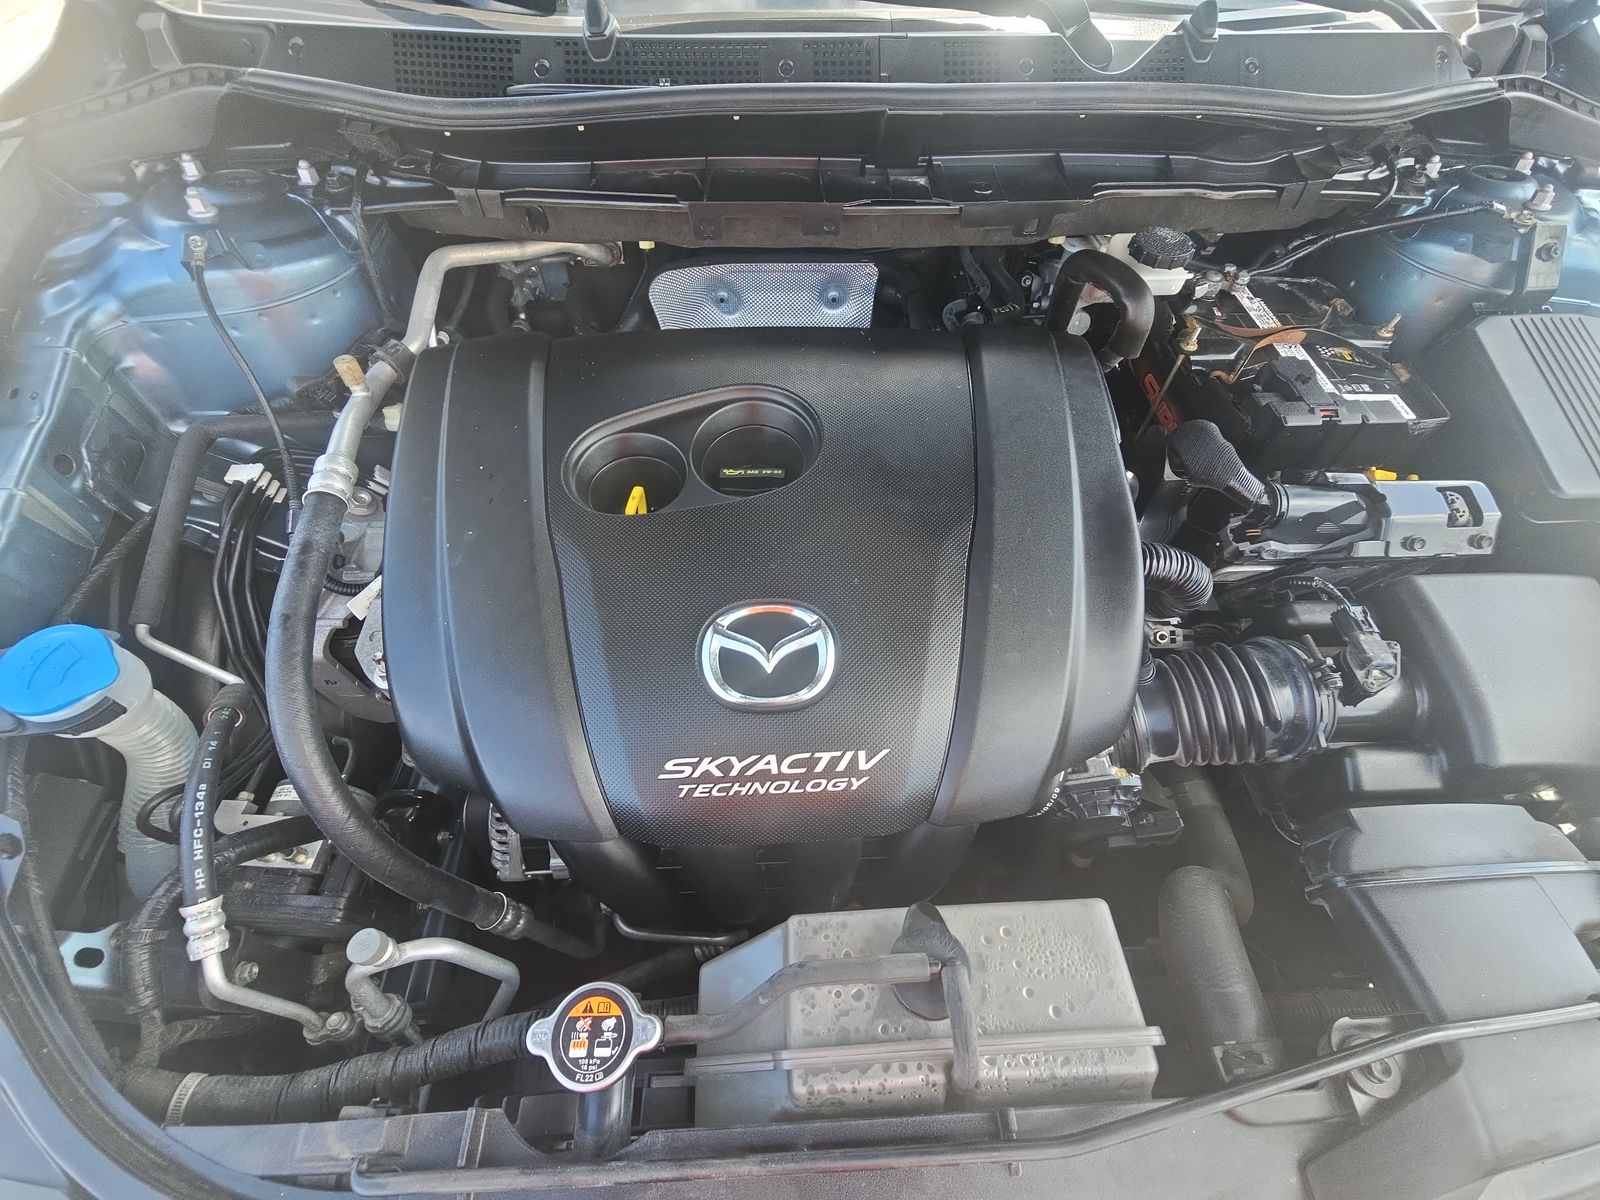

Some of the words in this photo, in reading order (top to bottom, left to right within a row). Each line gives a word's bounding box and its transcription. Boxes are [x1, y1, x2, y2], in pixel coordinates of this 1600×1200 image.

[657, 748, 892, 780] SKYACTIV
[677, 776, 871, 798] TECHNOLOGY
[193, 783, 207, 861] HFC-134a
[195, 868, 206, 890] HP
[575, 1073, 594, 1082] FL22
